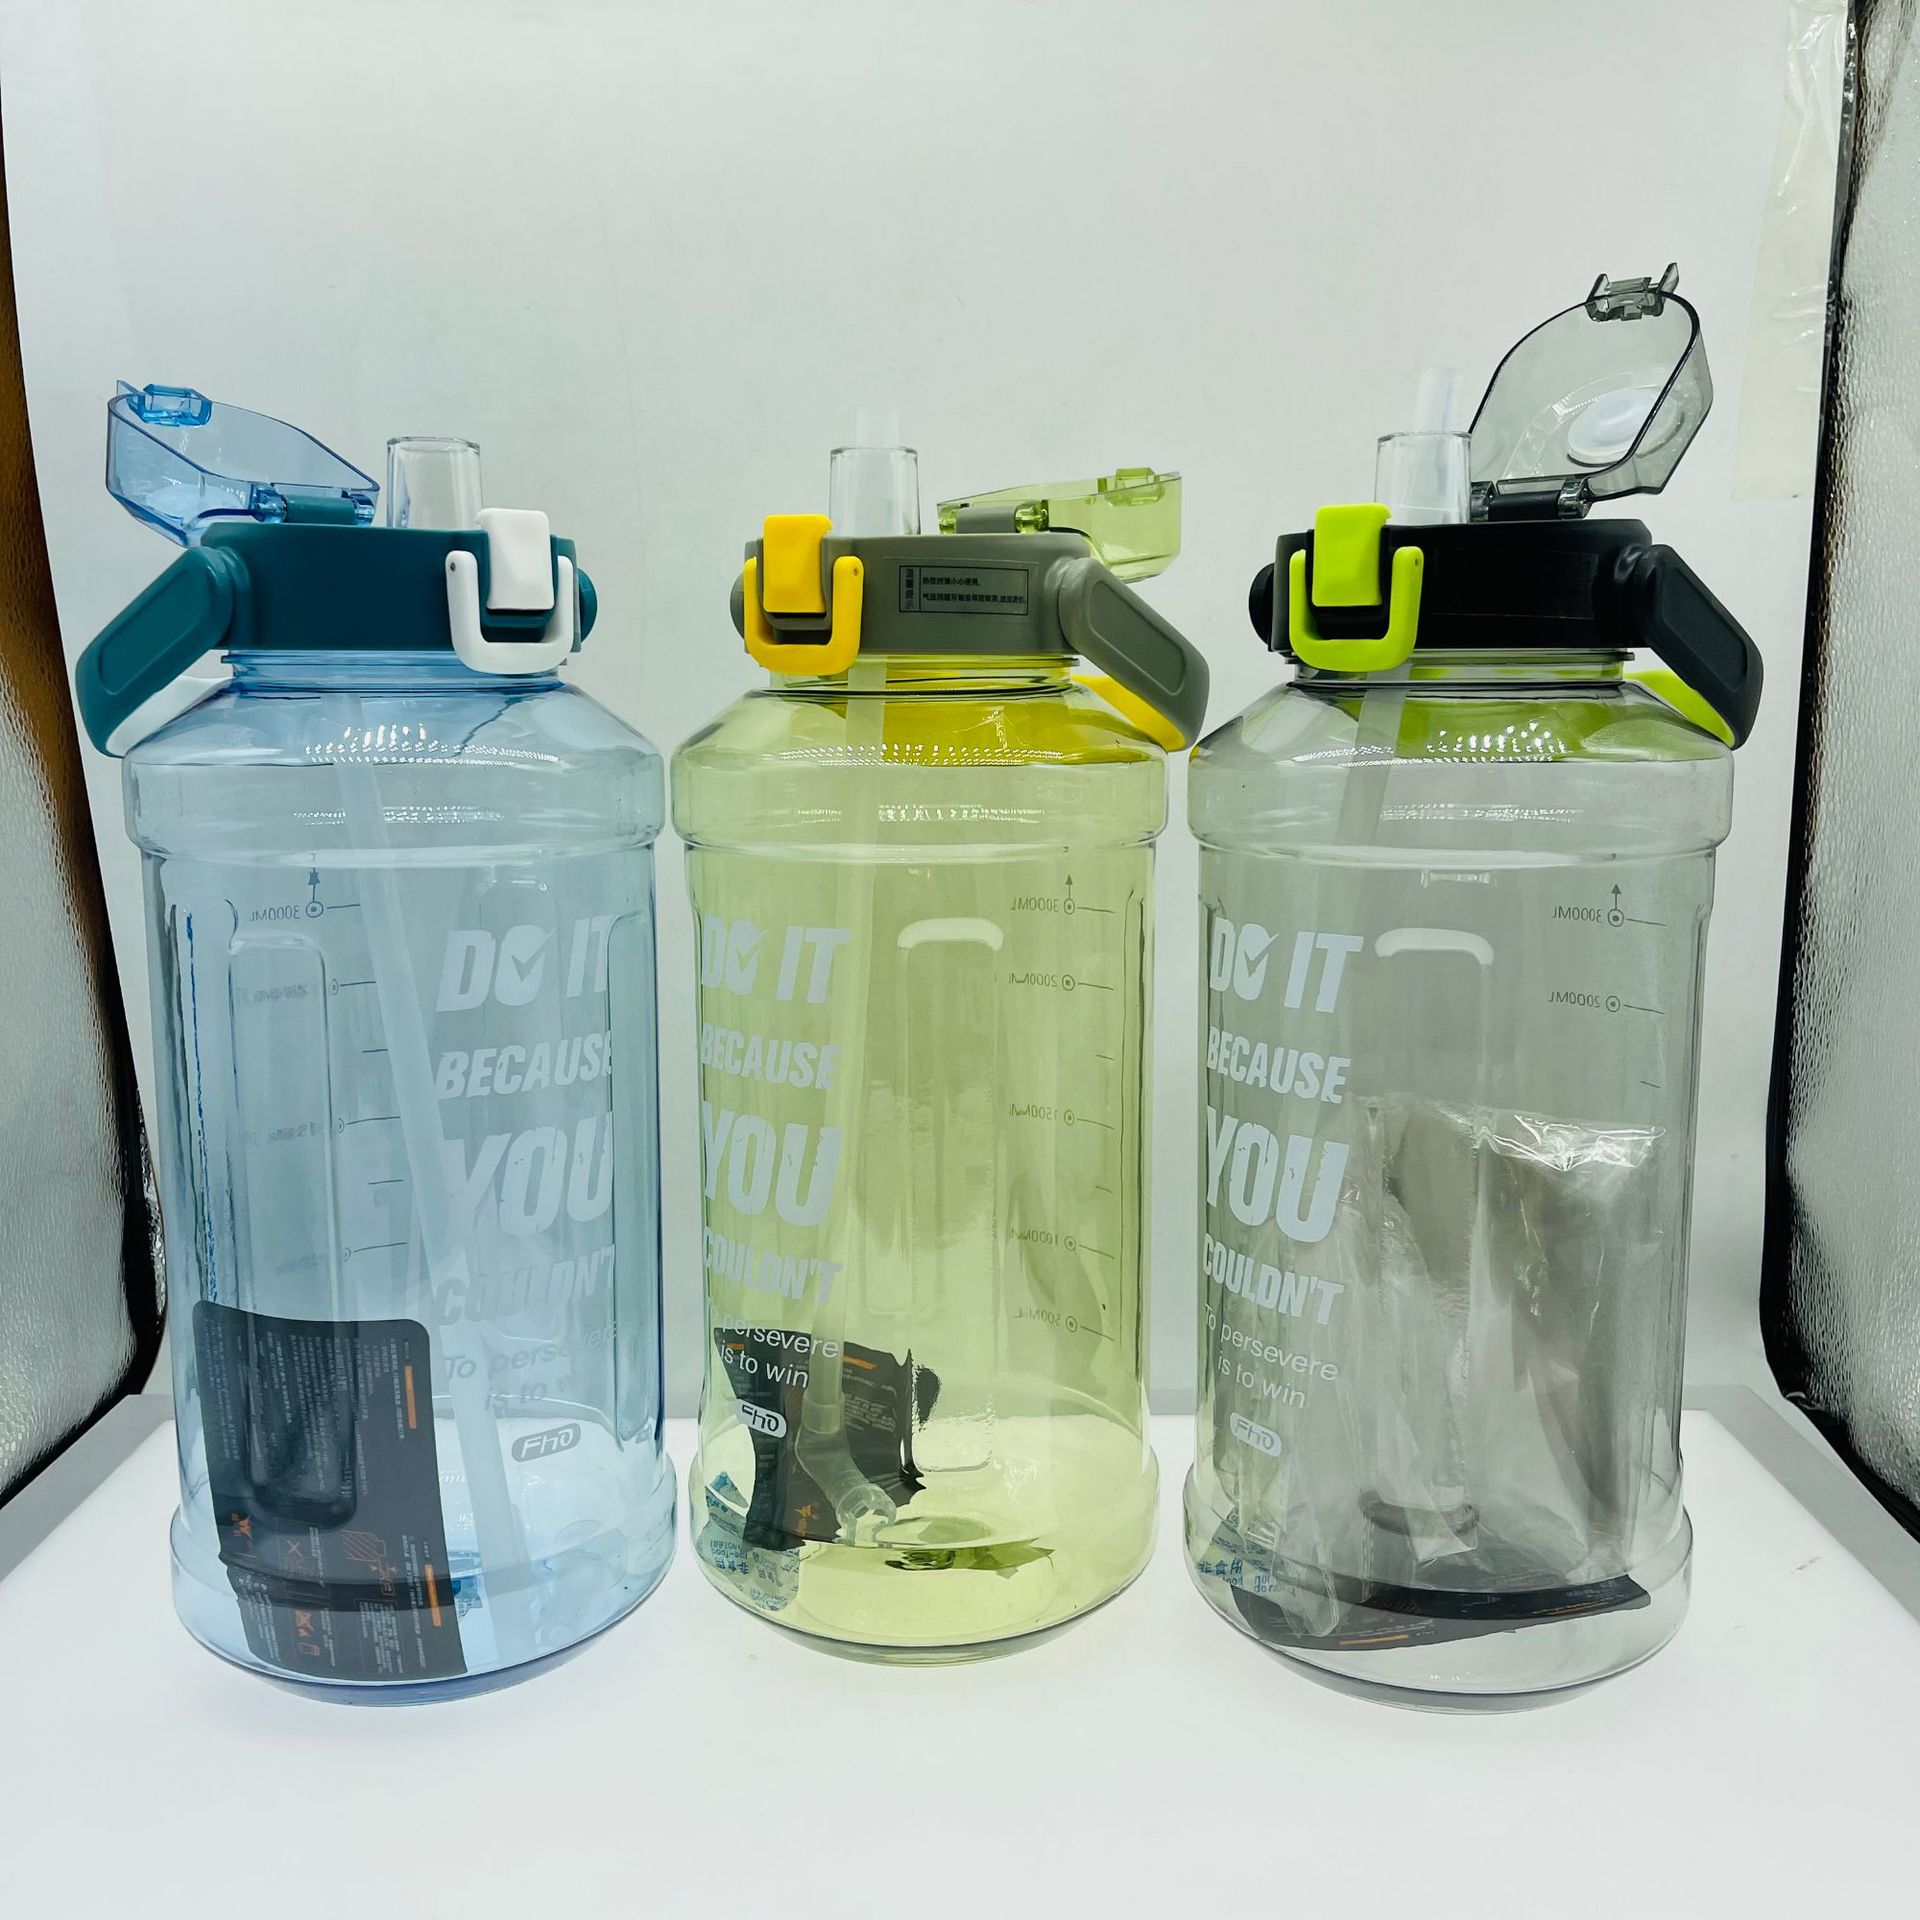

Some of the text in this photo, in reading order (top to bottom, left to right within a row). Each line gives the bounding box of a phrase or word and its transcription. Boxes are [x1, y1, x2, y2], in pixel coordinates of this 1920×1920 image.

[436, 915, 610, 1012] DO IT
[702, 914, 853, 1004] DO IT
[1209, 916, 1364, 1013] DO IT
[701, 1022, 844, 1090] BECAUSE
[1207, 1026, 1352, 1104] BECAUSE
[440, 1112, 613, 1240] YOU
[703, 1101, 845, 1226] YOU
[1206, 1105, 1350, 1243] YOU
[703, 1226, 844, 1305] COULDN'T
[1202, 1233, 1345, 1326] COULDN'T
[443, 1321, 617, 1380] To perseere
[720, 1340, 808, 1389] is to win
[722, 1313, 839, 1358] persevere
[1204, 1303, 1338, 1381] To persevere
[1218, 1351, 1306, 1408] is to win
